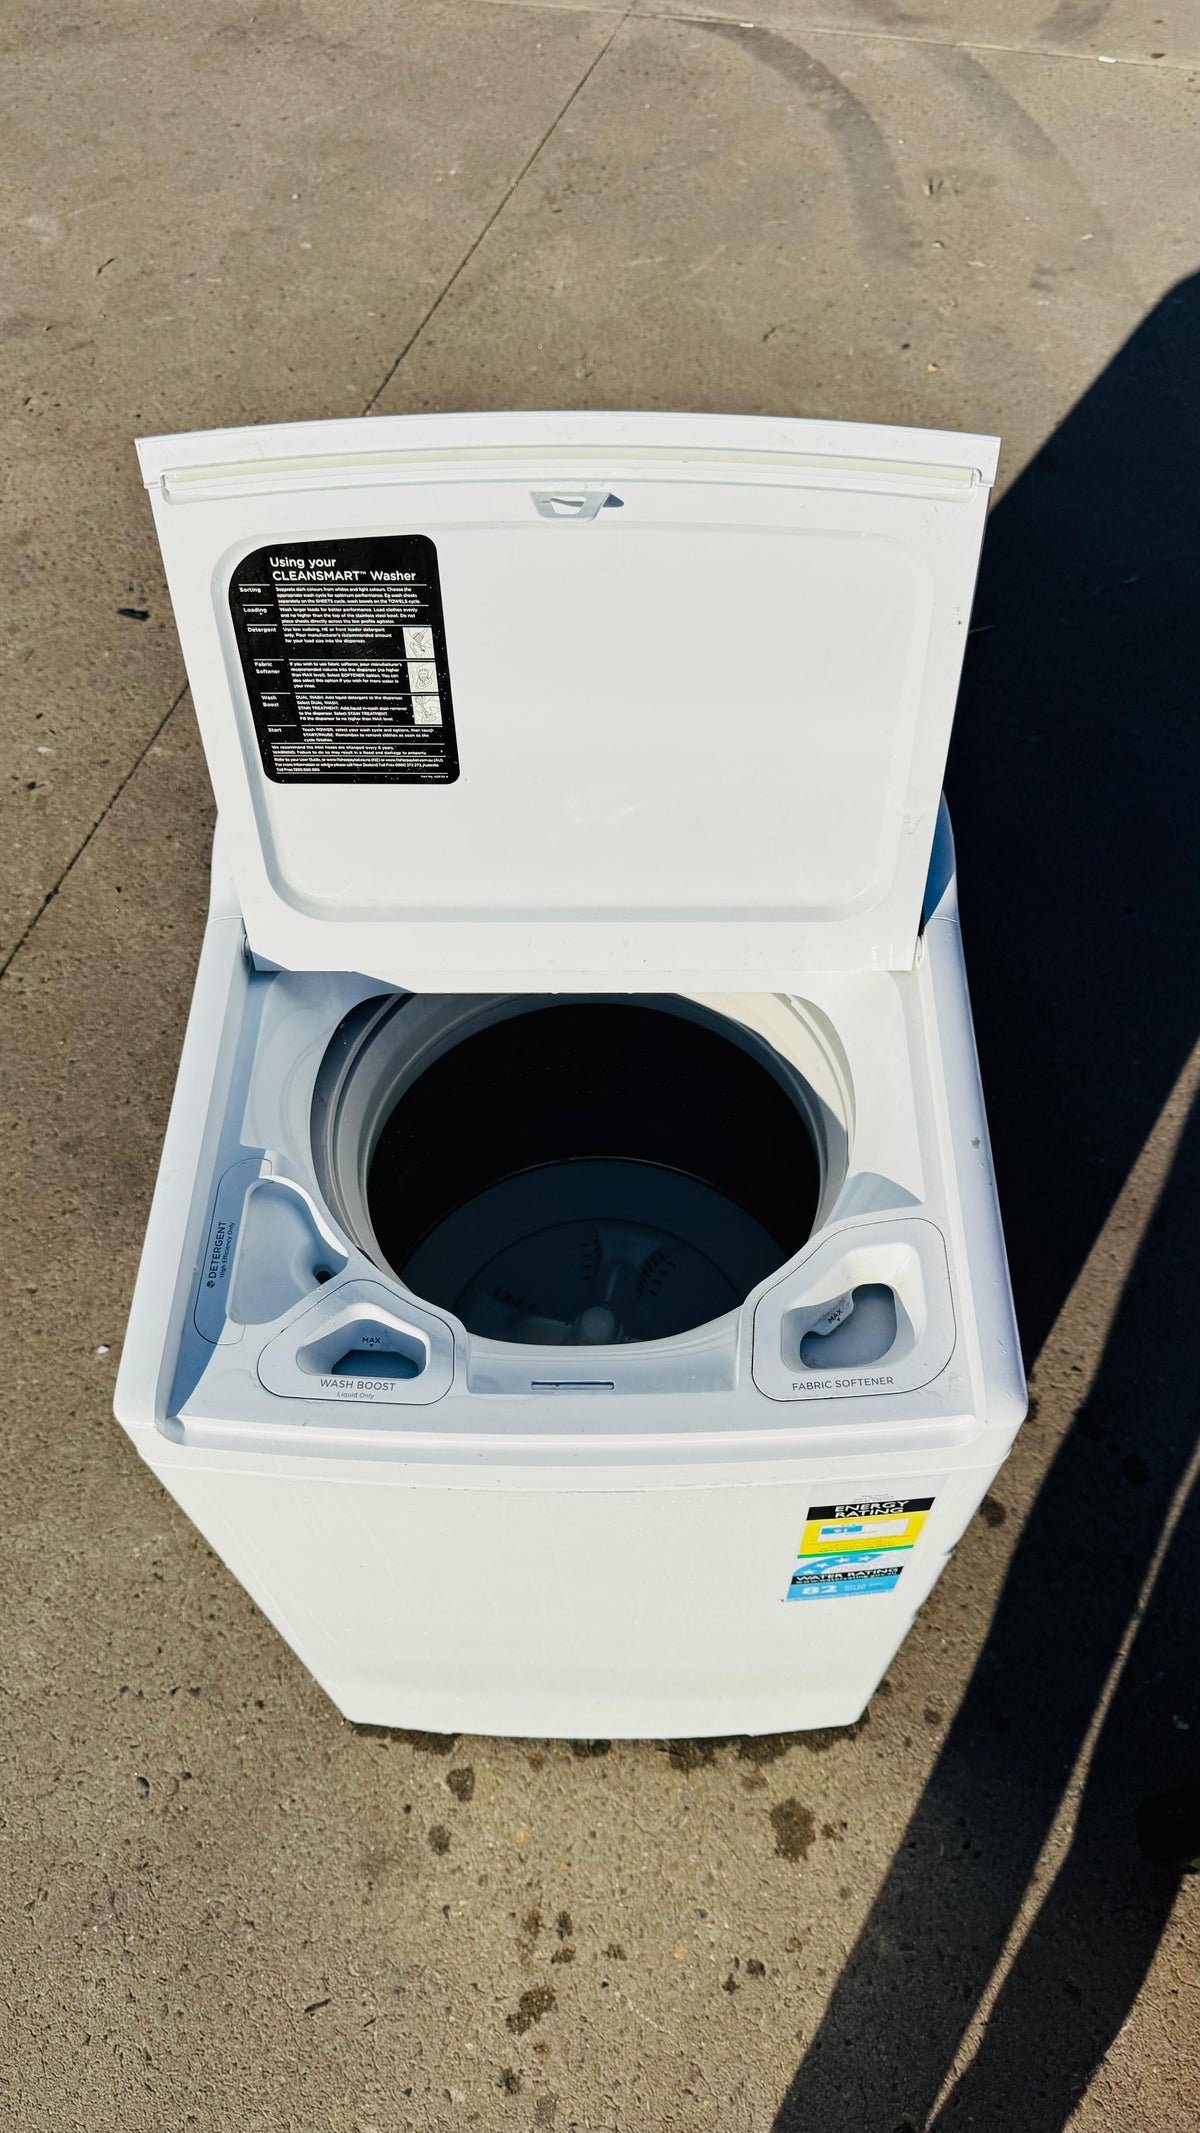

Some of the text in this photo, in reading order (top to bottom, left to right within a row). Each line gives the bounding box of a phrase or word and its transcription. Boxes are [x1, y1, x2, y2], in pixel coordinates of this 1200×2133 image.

[270, 557, 336, 568] Using your
[370, 570, 416, 580] Washer
[222, 1237, 232, 1263] Efficiency
[227, 1222, 235, 1235] Only
[208, 1221, 226, 1278] DETERGENT
[827, 1308, 843, 1324] MAX
[320, 1379, 396, 1391] WASH BOOST
[792, 1377, 894, 1391] FABRIC SOFTENER
[360, 1392, 375, 1400] Only
[835, 1500, 909, 1512] ENERGY
[835, 1508, 904, 1518] RATING
[847, 1568, 898, 1576] RATING
